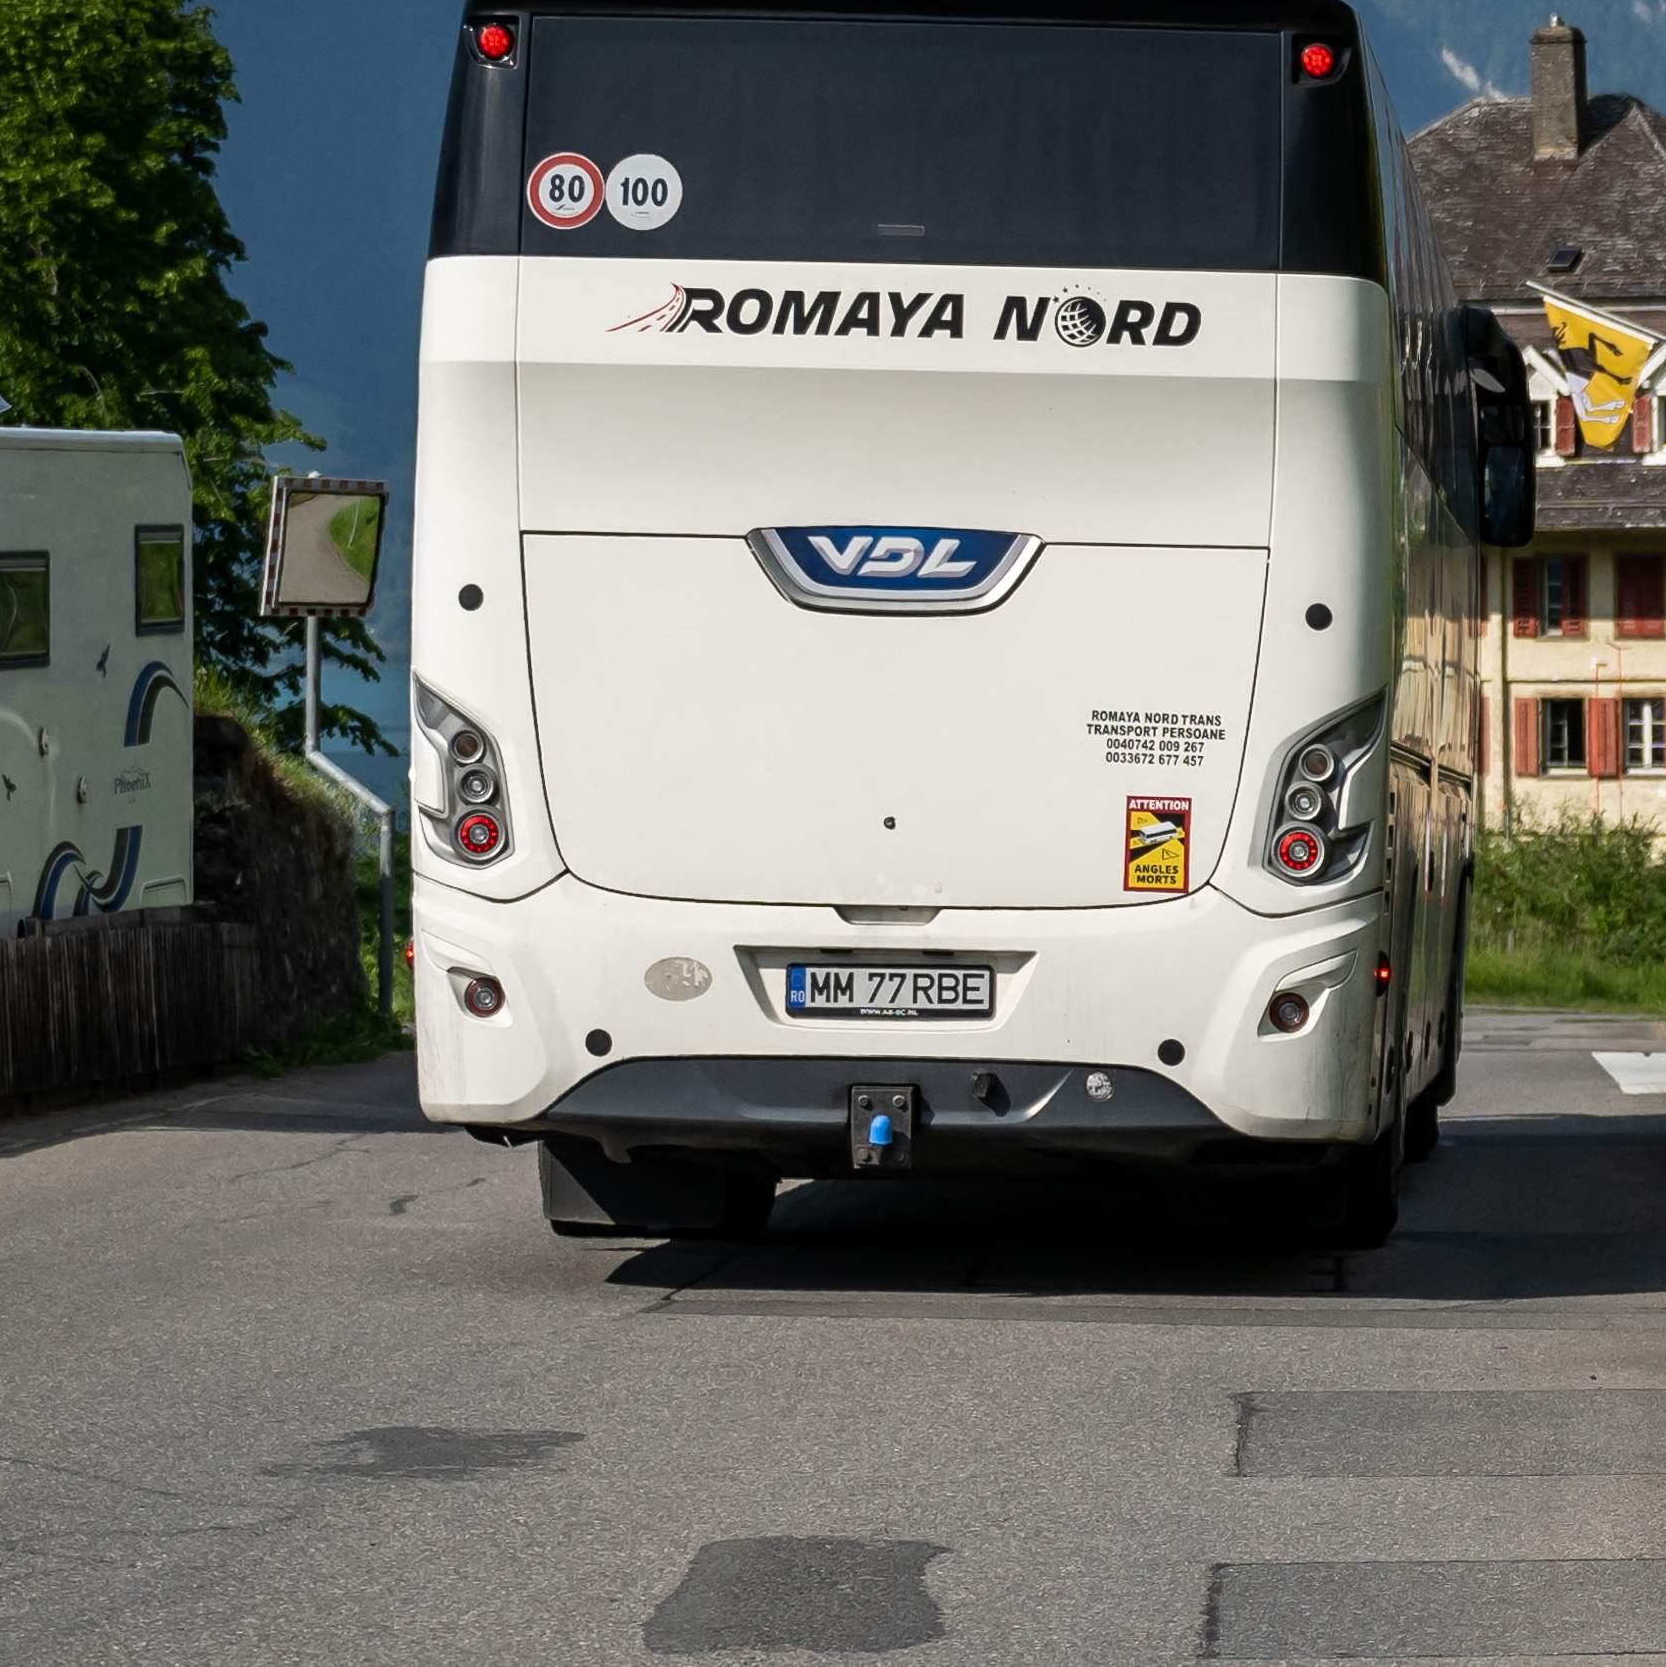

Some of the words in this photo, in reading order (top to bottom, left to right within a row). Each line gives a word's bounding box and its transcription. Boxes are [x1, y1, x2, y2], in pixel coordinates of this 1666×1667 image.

[549, 174, 585, 202] 80
[620, 177, 669, 207] 100
[661, 287, 965, 340] ROMAYA
[993, 295, 1202, 348] NORD
[807, 535, 977, 578] VDL
[1091, 710, 1141, 723] ROMAYA
[1144, 712, 1179, 725] NORD
[1181, 714, 1222, 726] TRANS
[1087, 723, 1158, 737] TRANSPORT
[1162, 726, 1226, 740] PERSOANE
[1106, 738, 1155, 751] 0040742
[1159, 740, 1180, 752] 009
[1184, 741, 1205, 753] 267
[1105, 752, 1155, 765] 0033672
[1158, 754, 1180, 766] 677
[1183, 755, 1205, 767] 457
[1129, 799, 1189, 811] ATTENTION
[1134, 864, 1179, 874] ANGLES
[1136, 875, 1177, 884] MORTS
[810, 971, 855, 1004] MM
[790, 990, 806, 1003] RO
